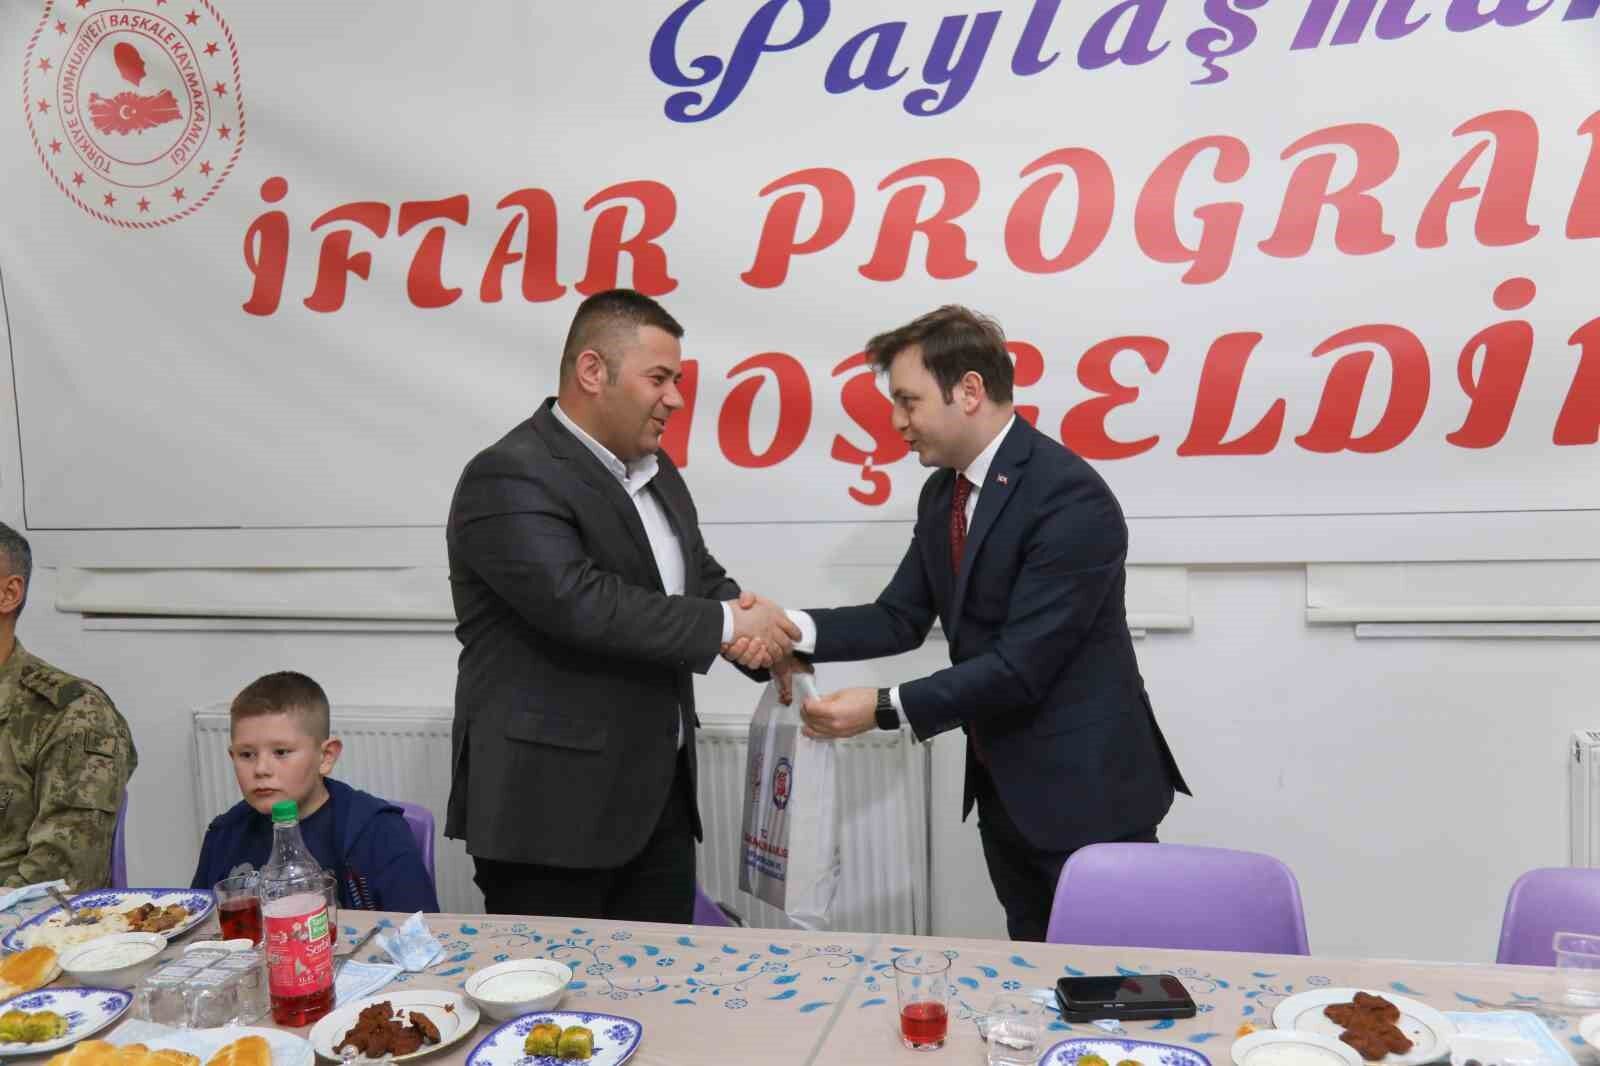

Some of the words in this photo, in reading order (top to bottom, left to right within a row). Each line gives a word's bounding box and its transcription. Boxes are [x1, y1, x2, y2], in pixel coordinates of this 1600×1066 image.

[63, 15, 107, 114] CUMHURİYETİ
[109, 14, 177, 45] BAŞKALE
[650, 0, 1600, 124] Paylaşm
[67, 119, 112, 174] TÜRKİYE
[170, 41, 205, 166] KAYMAKAMLIĞI
[242, 176, 679, 316] İFTAR
[740, 109, 1600, 288] PROGRA
